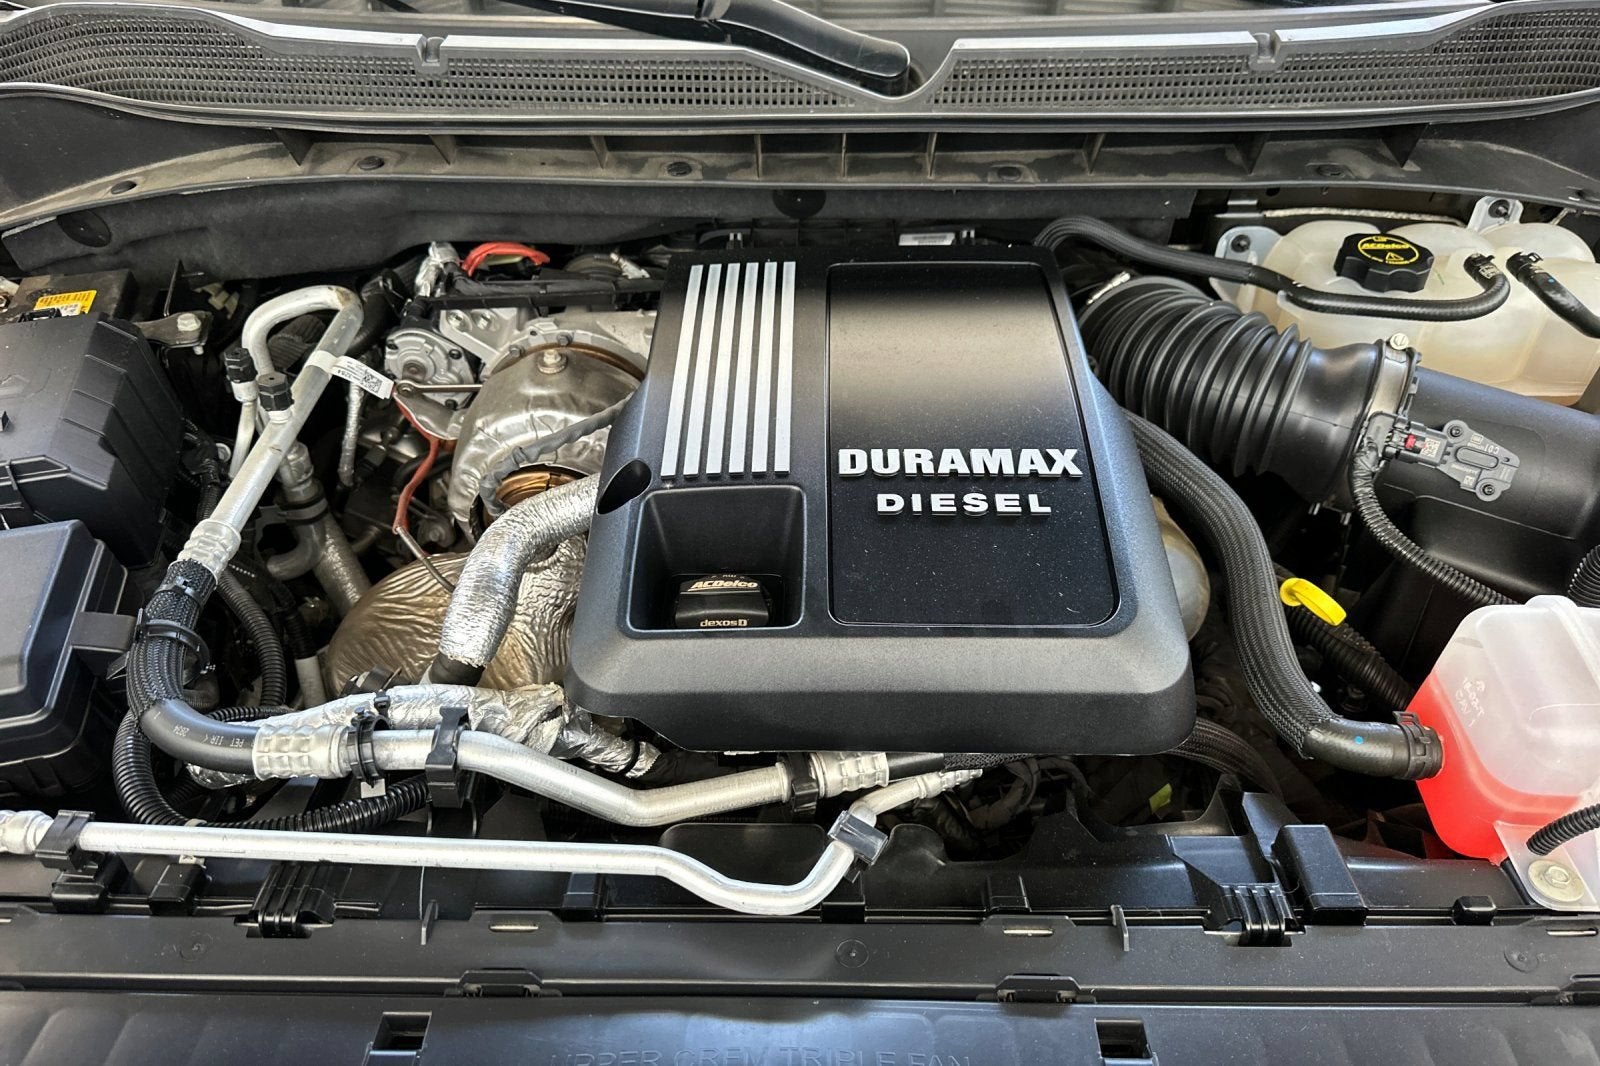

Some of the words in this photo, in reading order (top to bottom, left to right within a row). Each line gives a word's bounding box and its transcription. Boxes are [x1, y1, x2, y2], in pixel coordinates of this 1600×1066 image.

[838, 448, 1083, 477] DURAMAX
[876, 492, 1052, 516] DIESEL
[688, 580, 759, 590] ACDelco
[551, 1049, 663, 1066] UPPER
[779, 1046, 897, 1066] TRIPLE
[907, 1052, 970, 1066] FAN
